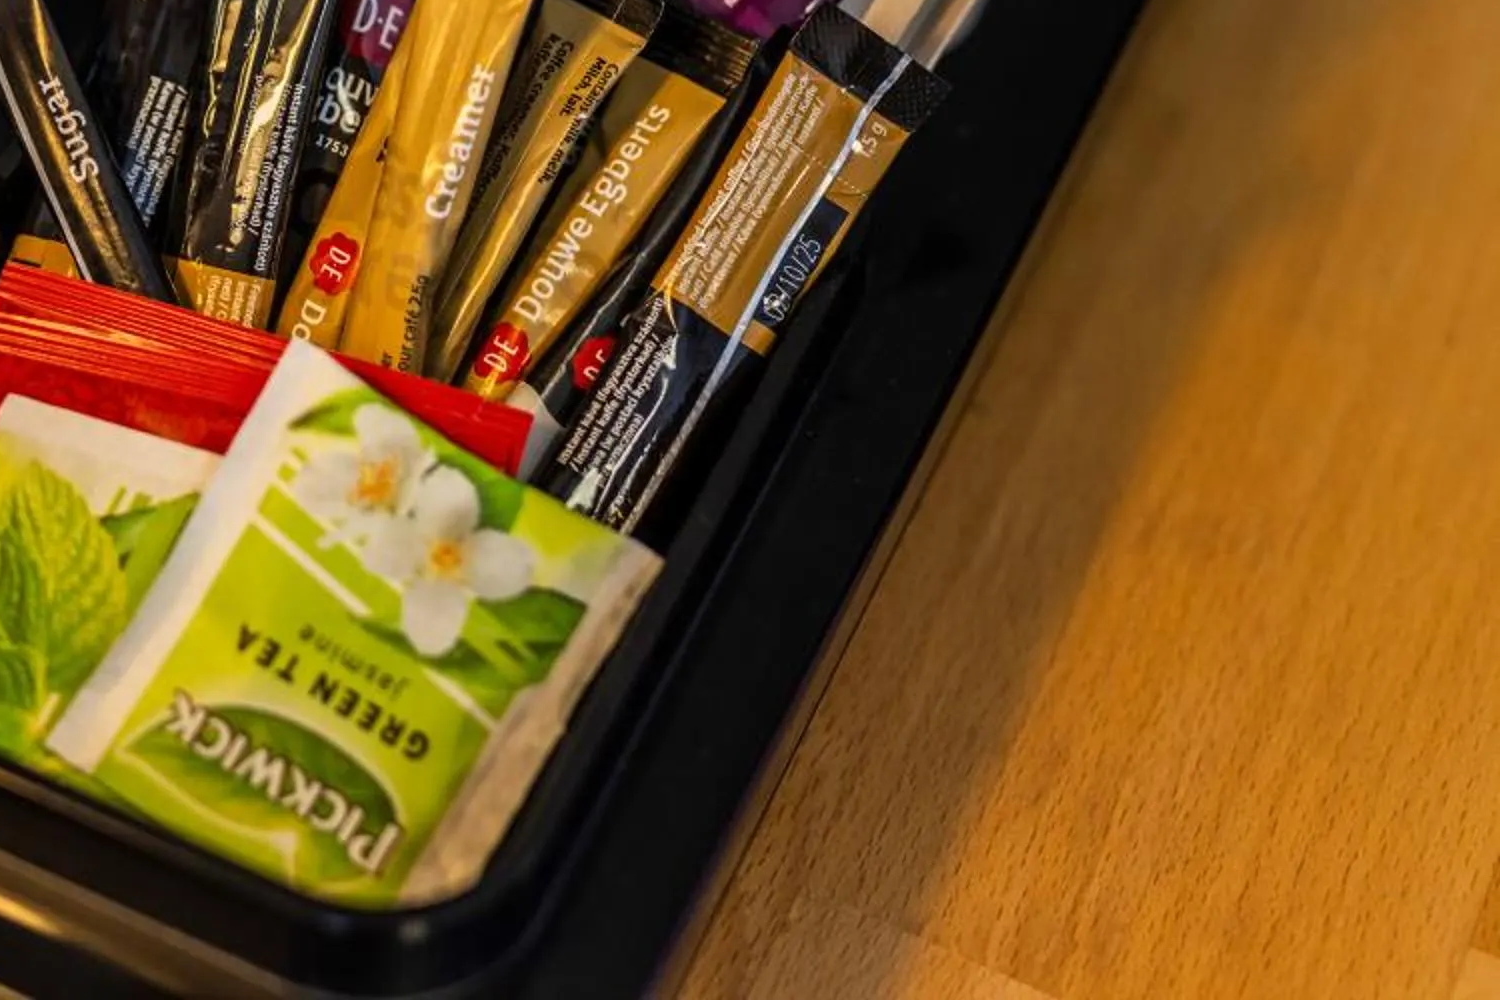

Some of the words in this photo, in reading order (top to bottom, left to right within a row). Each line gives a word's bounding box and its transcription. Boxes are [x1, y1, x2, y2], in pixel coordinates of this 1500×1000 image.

[538, 36, 575, 84] Coffee
[578, 59, 620, 118] Contains
[39, 75, 99, 184] Sugar
[313, 133, 350, 156] 1753
[425, 67, 496, 220] Creamer
[514, 215, 594, 323] Douwe
[582, 105, 670, 215] Egberts
[555, 424, 586, 466] Instant
[572, 424, 603, 465] Instant
[235, 621, 297, 685] TEA
[298, 621, 412, 698] jasmine
[308, 672, 431, 762] GREEN
[167, 687, 401, 878] PICKWICK
